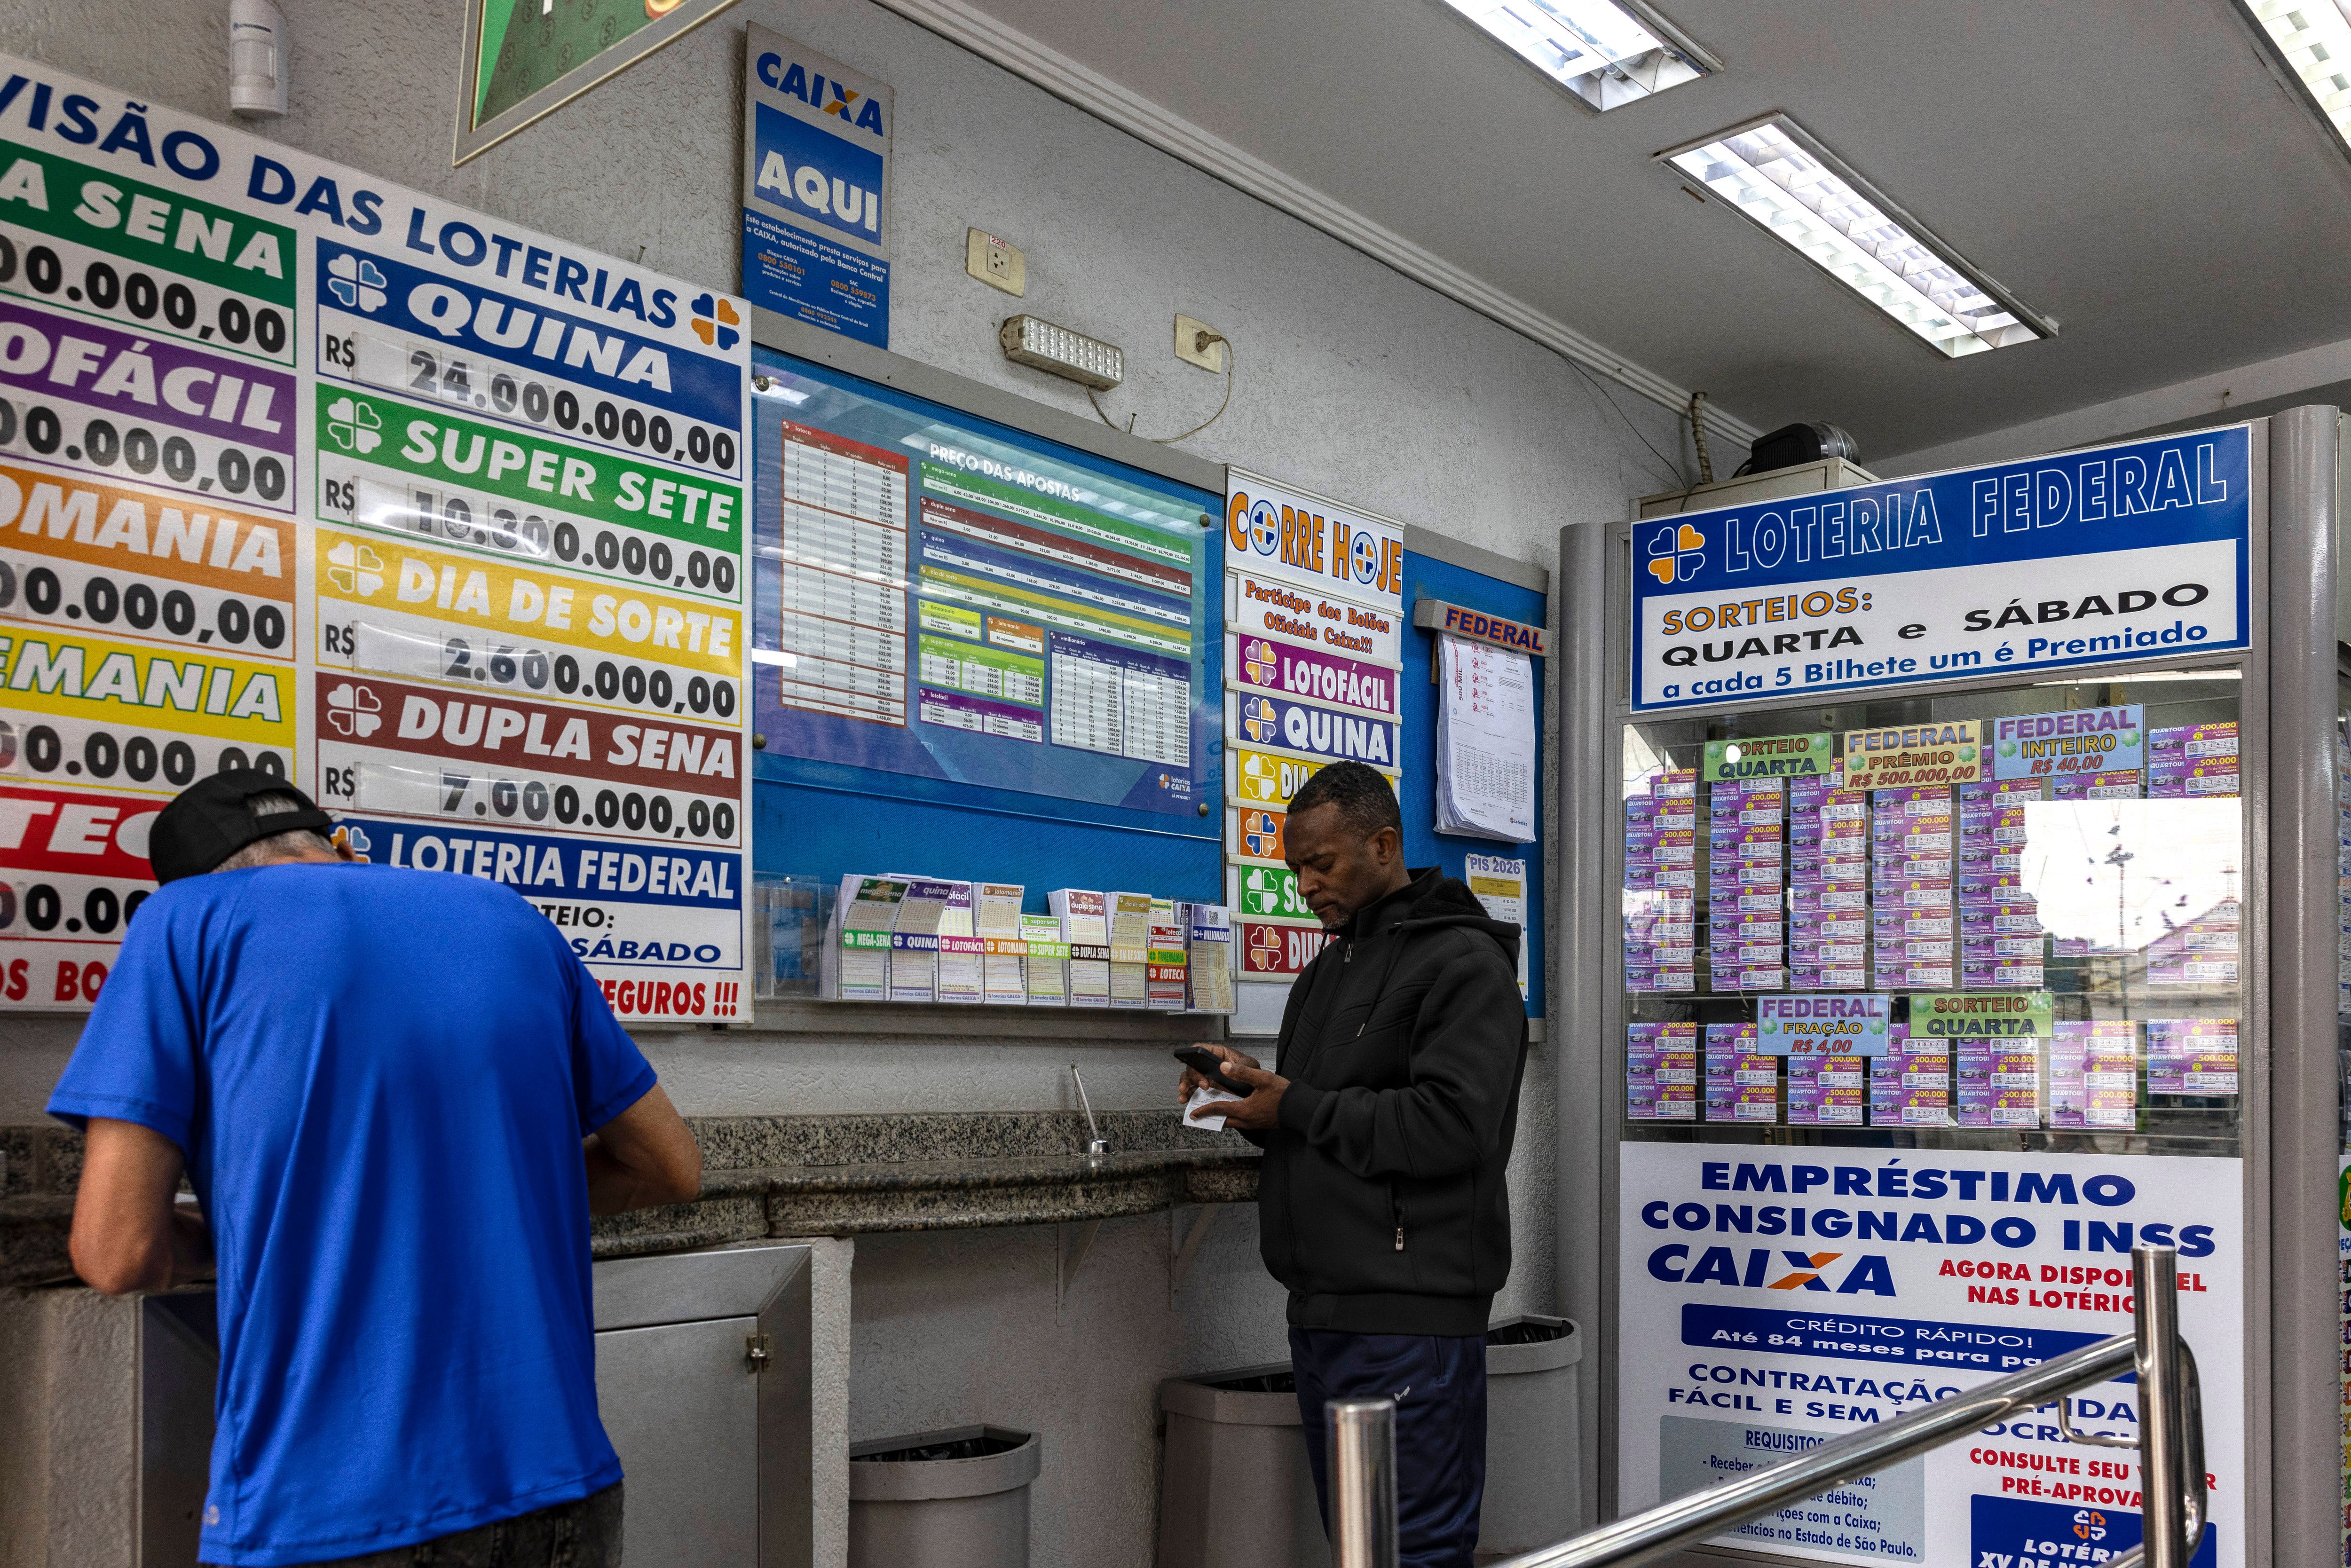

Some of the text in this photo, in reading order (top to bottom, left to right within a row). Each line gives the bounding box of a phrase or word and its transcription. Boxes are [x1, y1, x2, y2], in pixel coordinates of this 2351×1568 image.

[757, 52, 883, 137] CAIXA
[757, 150, 877, 232] AQUI
[73, 180, 284, 279] SENA
[247, 155, 384, 236] DAS
[406, 207, 678, 329] LOTERIAS
[992, 236, 1005, 248] 220
[746, 214, 886, 274] Este estabelecimento presta serviços para
[753, 228, 779, 244] CAIXA,
[781, 238, 818, 258] autorizado
[821, 254, 836, 265] pelo
[837, 260, 858, 273] Banco
[860, 268, 883, 282] Central
[767, 249, 797, 264] Disque CAIXA
[758, 252, 805, 276] 0800 550101
[763, 263, 801, 281] Informações sobre
[762, 269, 781, 281] produtos
[786, 277, 801, 287] serviços
[831, 279, 848, 291] 0800
[408, 282, 672, 393] QUINA
[326, 334, 735, 470] R$ 24.000.000,00
[795, 426, 811, 435] loteca
[401, 420, 733, 532] SUPER SETE
[930, 443, 1080, 502] PREÇO DAS APOSTAS
[932, 466, 956, 478] mega-sena
[931, 501, 944, 510] dupla
[1726, 443, 2227, 573] LOTERIA FEDERAL
[325, 479, 735, 593] R$ 10.300.000,00
[1228, 491, 1402, 596] CORRE HOJE
[396, 559, 733, 657] DIA DE SORTE
[1245, 579, 1389, 634] Participe dos Bolões
[1662, 587, 1872, 636] SORTEIOS:
[998, 620, 1020, 630] lotomania
[1264, 611, 1373, 654] Oficiais Caixa!!!
[1444, 606, 1544, 653] FEDERAL
[1662, 583, 2209, 667] QUARTA e SÁBADO
[1061, 637, 1085, 646] +milionária
[325, 624, 735, 718] R$ 2.600.000,00
[1663, 620, 2208, 698] a cada 5 Bilhete um é Premiado
[930, 692, 948, 701] lotofácil
[1284, 657, 1389, 712] LOTOFÁCIL
[397, 695, 735, 779] DUPLA SENA
[1284, 706, 1389, 763] QUINA
[1848, 724, 1975, 753] FEDERAL
[1999, 709, 2137, 741] FEDERAL
[2200, 721, 2236, 731] 500.000
[1726, 738, 1809, 757] ORTEIO
[2021, 733, 2116, 759] INTEIRO
[1719, 757, 1816, 778] QUARTA
[1868, 751, 1955, 770] PRÊMIO
[2030, 754, 2103, 775] R$ 40,00
[1171, 776, 1190, 786] loterias
[1171, 783, 1190, 792] CAIXA
[1848, 765, 1975, 788] R$ 500.000,00
[325, 766, 735, 840] R$ 7.000.000,00
[389, 833, 734, 899] LOTERIA FEDERAL
[1470, 857, 1521, 875] PIS 2026
[572, 934, 721, 963] SÁBADO
[857, 933, 891, 947] MEGA-SENA
[907, 936, 938, 949] QUINA
[952, 939, 984, 953] LOTOFÁCIL
[998, 941, 1027, 954] LOTOMANIA
[1037, 944, 1068, 957] SUPER SETE
[1080, 946, 1109, 959] DUPLA SENA
[1158, 950, 1184, 963] TIMEMANIA
[1160, 968, 1184, 980] LOTECA
[714, 982, 738, 1016] !!!
[1762, 999, 1883, 1018] FEDERAL
[1934, 996, 2028, 1014] SORTEIO
[1783, 1020, 1862, 1037] FRAÇÃO
[1927, 1018, 2038, 1036] QUARTA
[1791, 1039, 1852, 1056] R$ 4,00
[1702, 1158, 2136, 1207] EMPRÉSTIMO
[1641, 1201, 2215, 1258] CONSIGNADO INSS
[1647, 1243, 1897, 1297] CAIXA
[1938, 1259, 2032, 1282] AGORA
[1968, 1285, 2020, 1306] NAS
[1712, 1329, 1997, 1363] Até 84 meses para
[1786, 1319, 2032, 1348] CRÉDITO RÁPIDO!
[1688, 1363, 1964, 1405] CONTRATAÇÃO
[1669, 1387, 1880, 1423] FÁCIL E SEM
[1970, 1448, 2129, 1480] CONSULTE SEU
[1827, 1490, 1868, 1510] débito;
[1807, 1511, 1881, 1533] com a Caixa;
[1778, 1528, 1917, 1557] no Estado de São Paulo.
